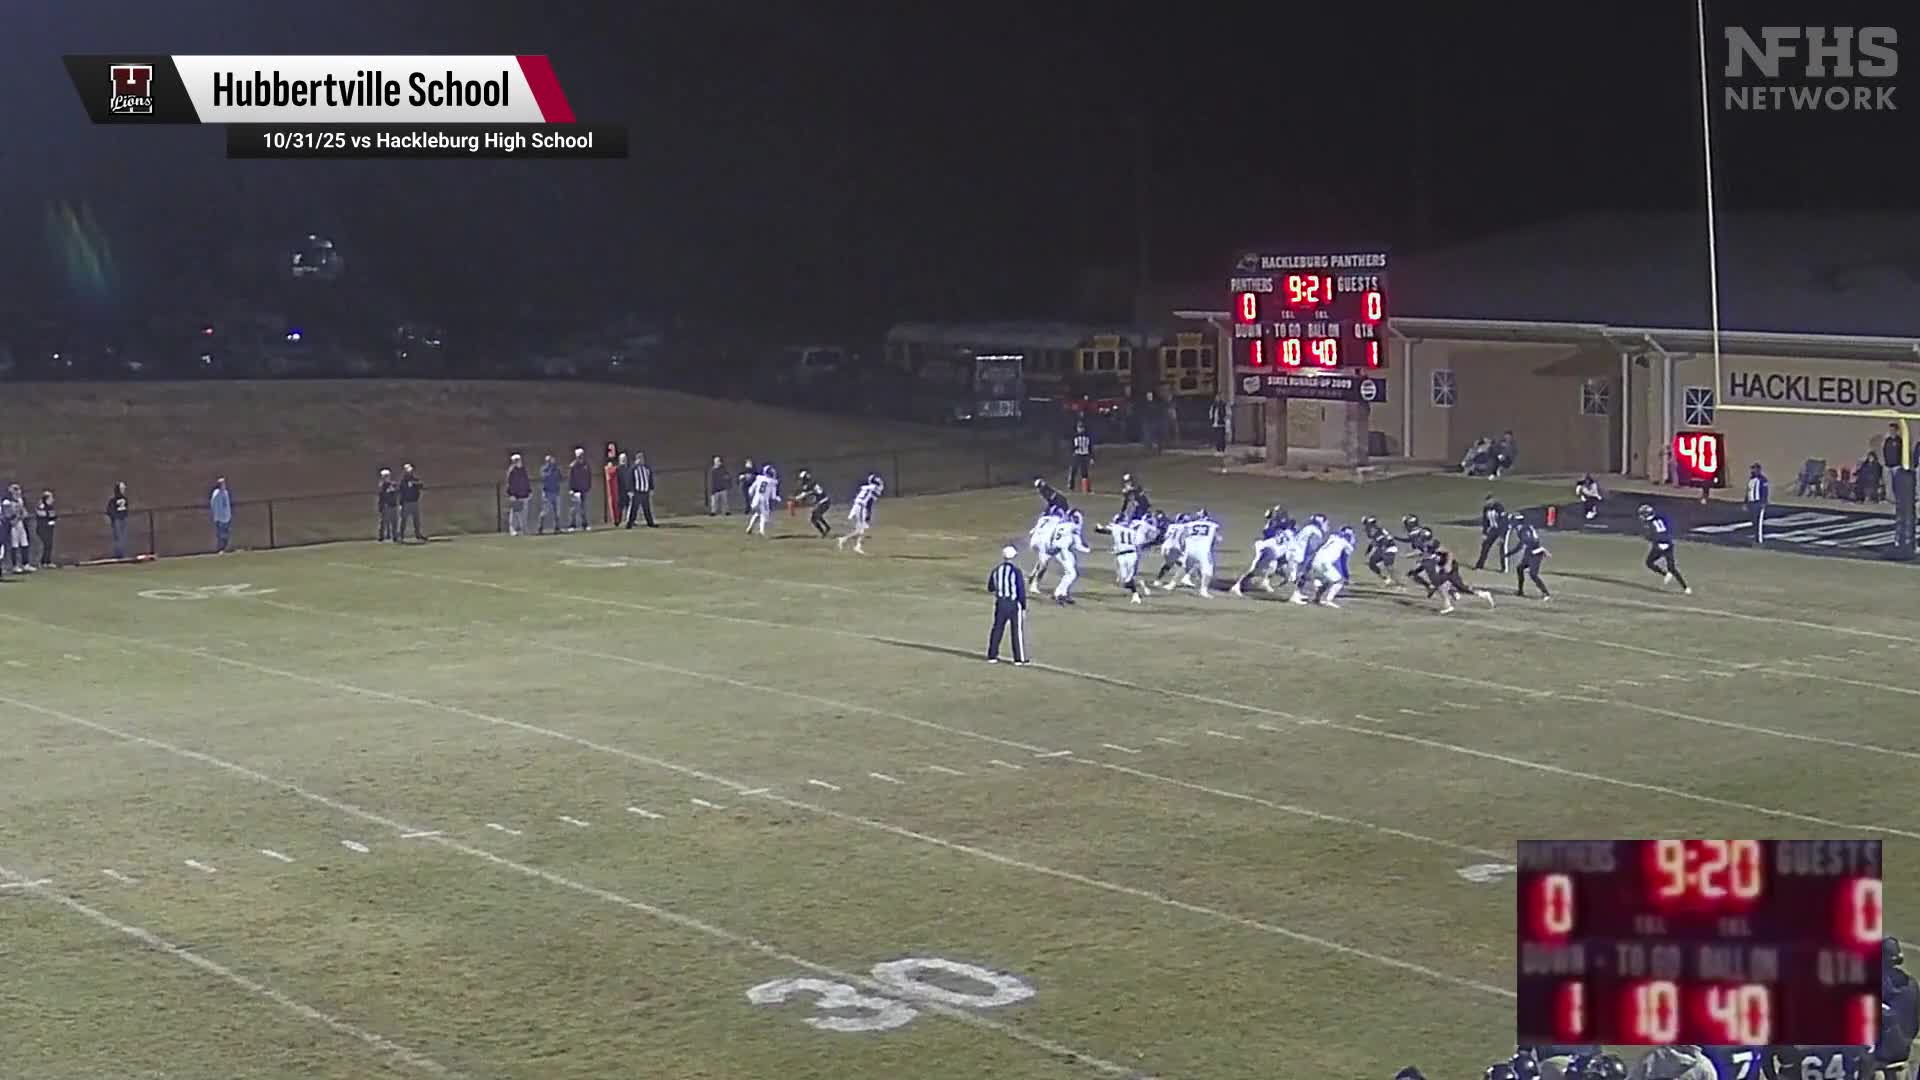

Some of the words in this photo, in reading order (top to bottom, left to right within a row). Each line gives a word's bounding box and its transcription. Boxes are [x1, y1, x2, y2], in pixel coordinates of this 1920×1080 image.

[1261, 256, 1328, 269] HACKLEBURG
[1330, 254, 1386, 268] PANTHERS
[1231, 278, 1273, 292] PANTHERS
[1289, 275, 1332, 303] 9:21
[1338, 277, 1378, 292] GUESTS
[1243, 293, 1256, 320] 0
[1368, 292, 1381, 320] 0
[1274, 323, 1287, 338] TO
[1288, 323, 1301, 338] GO
[1283, 339, 1300, 366] 10
[1311, 339, 1337, 366] 40
[1730, 372, 1917, 407] HACKLEBURG
[1679, 435, 1717, 473] 40
[746, 958, 1036, 1031] 30
[1801, 1054, 1846, 1080] 64
